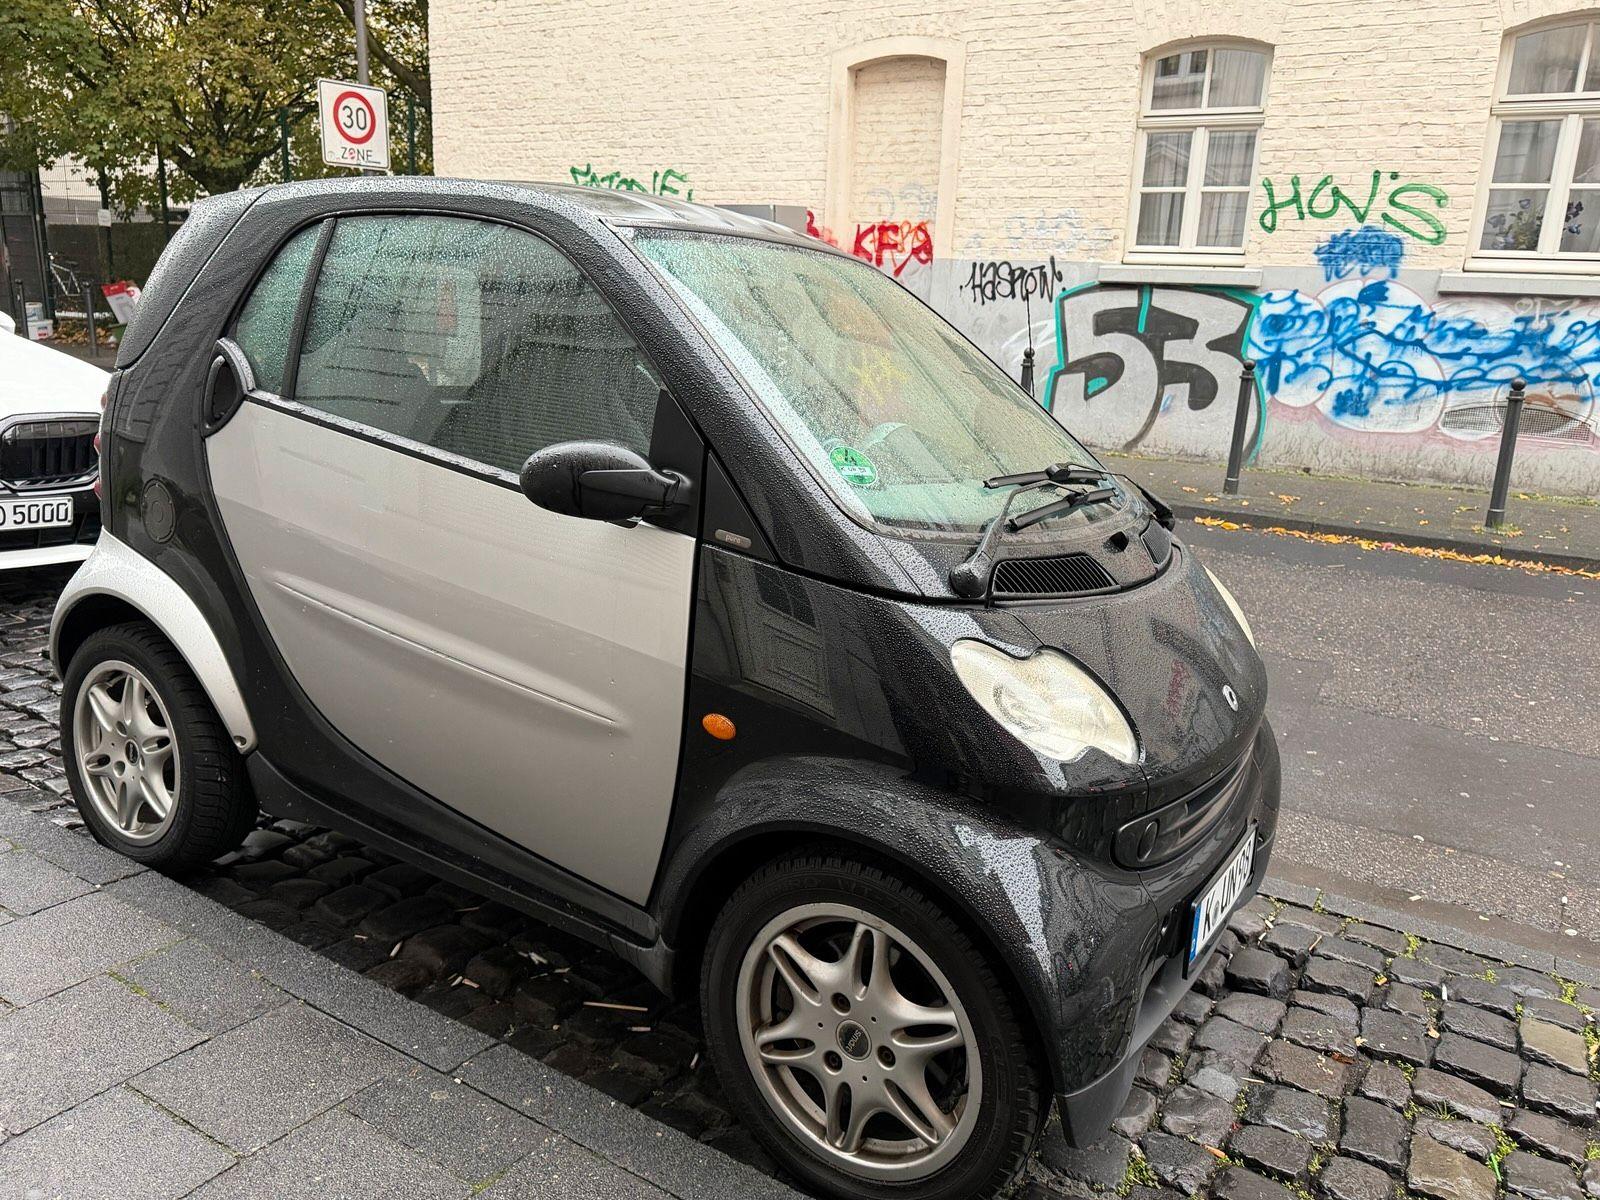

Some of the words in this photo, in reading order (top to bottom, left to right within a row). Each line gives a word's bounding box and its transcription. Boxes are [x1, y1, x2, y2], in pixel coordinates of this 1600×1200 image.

[342, 105, 367, 131] 30
[12, 502, 69, 525] 5000
[845, 1029, 862, 1053] smart
